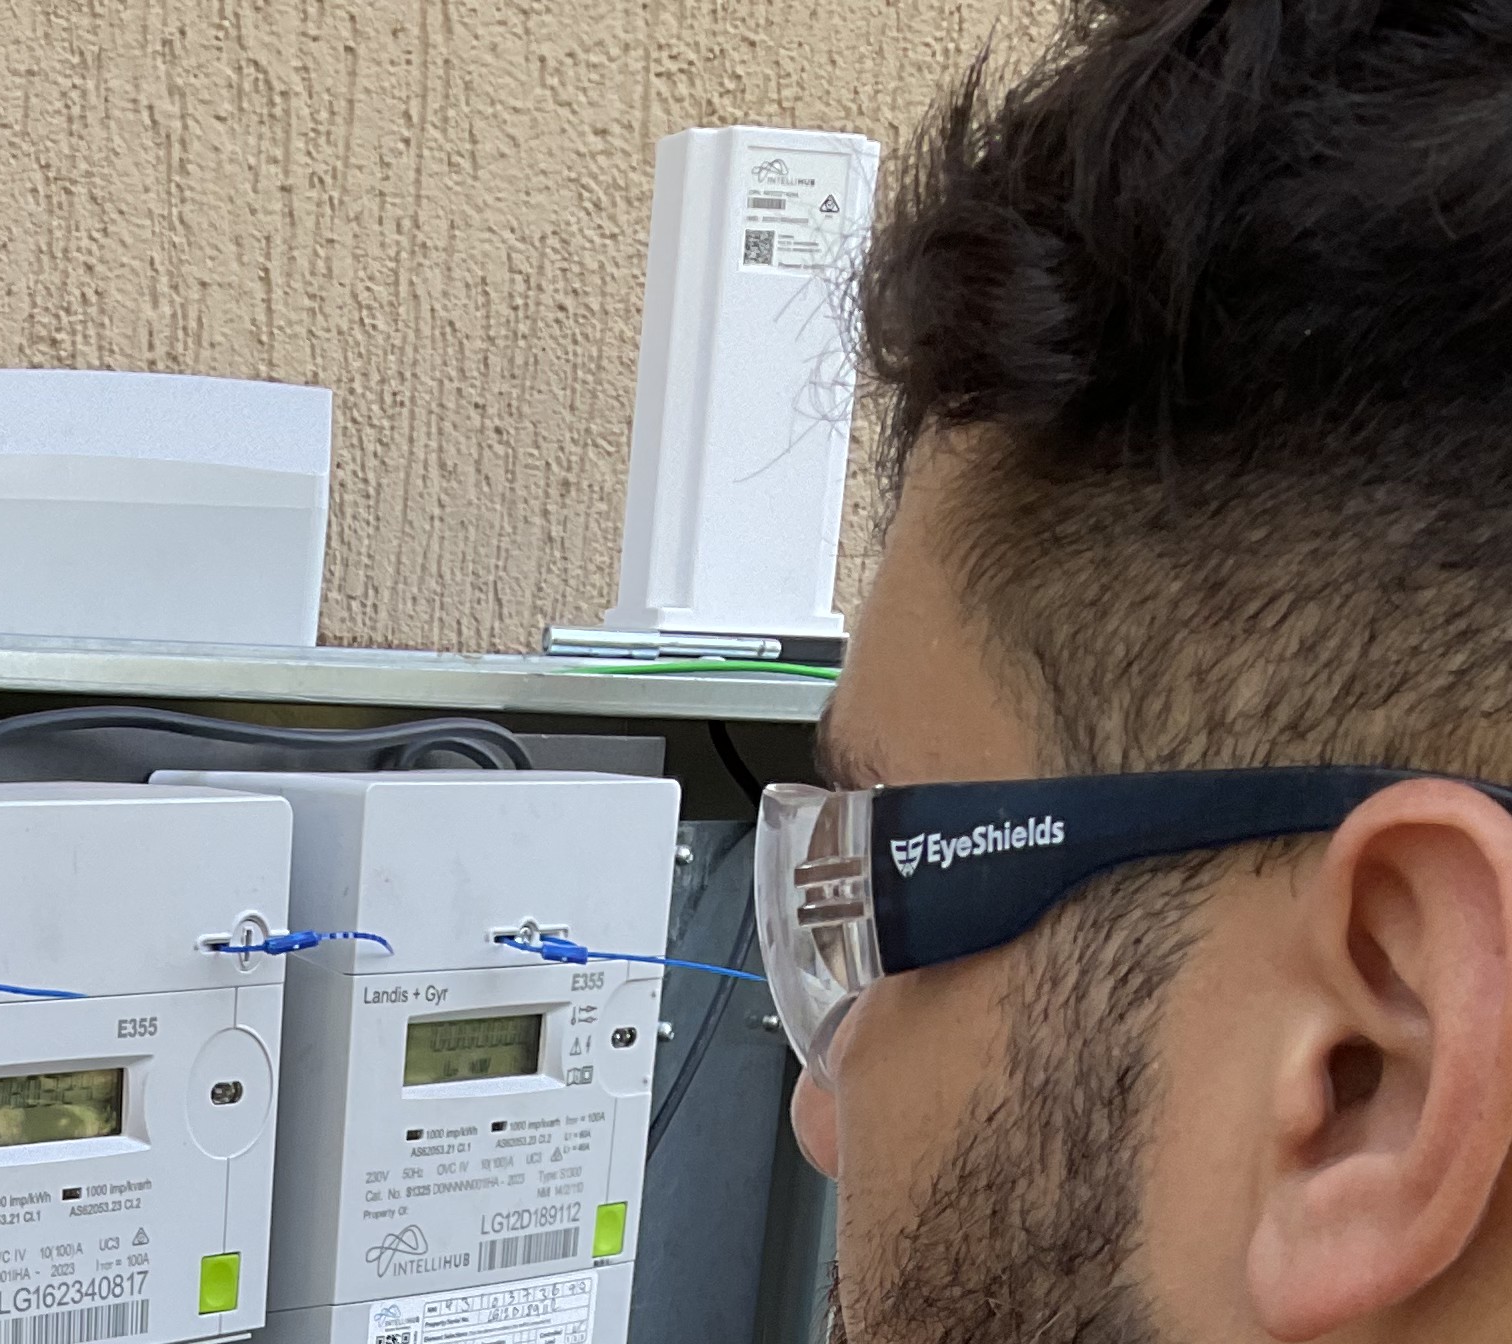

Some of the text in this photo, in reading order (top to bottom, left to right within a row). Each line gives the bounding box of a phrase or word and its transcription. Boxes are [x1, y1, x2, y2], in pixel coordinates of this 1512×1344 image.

[926, 815, 1066, 869] EyeShields
[571, 971, 605, 991] E355
[363, 987, 409, 1004] Landis
[425, 985, 449, 1006] Gyr
[117, 1016, 159, 1039] E355
[480, 1201, 581, 1235] LG12D189112
[393, 1252, 471, 1277] INTELLIHUB
